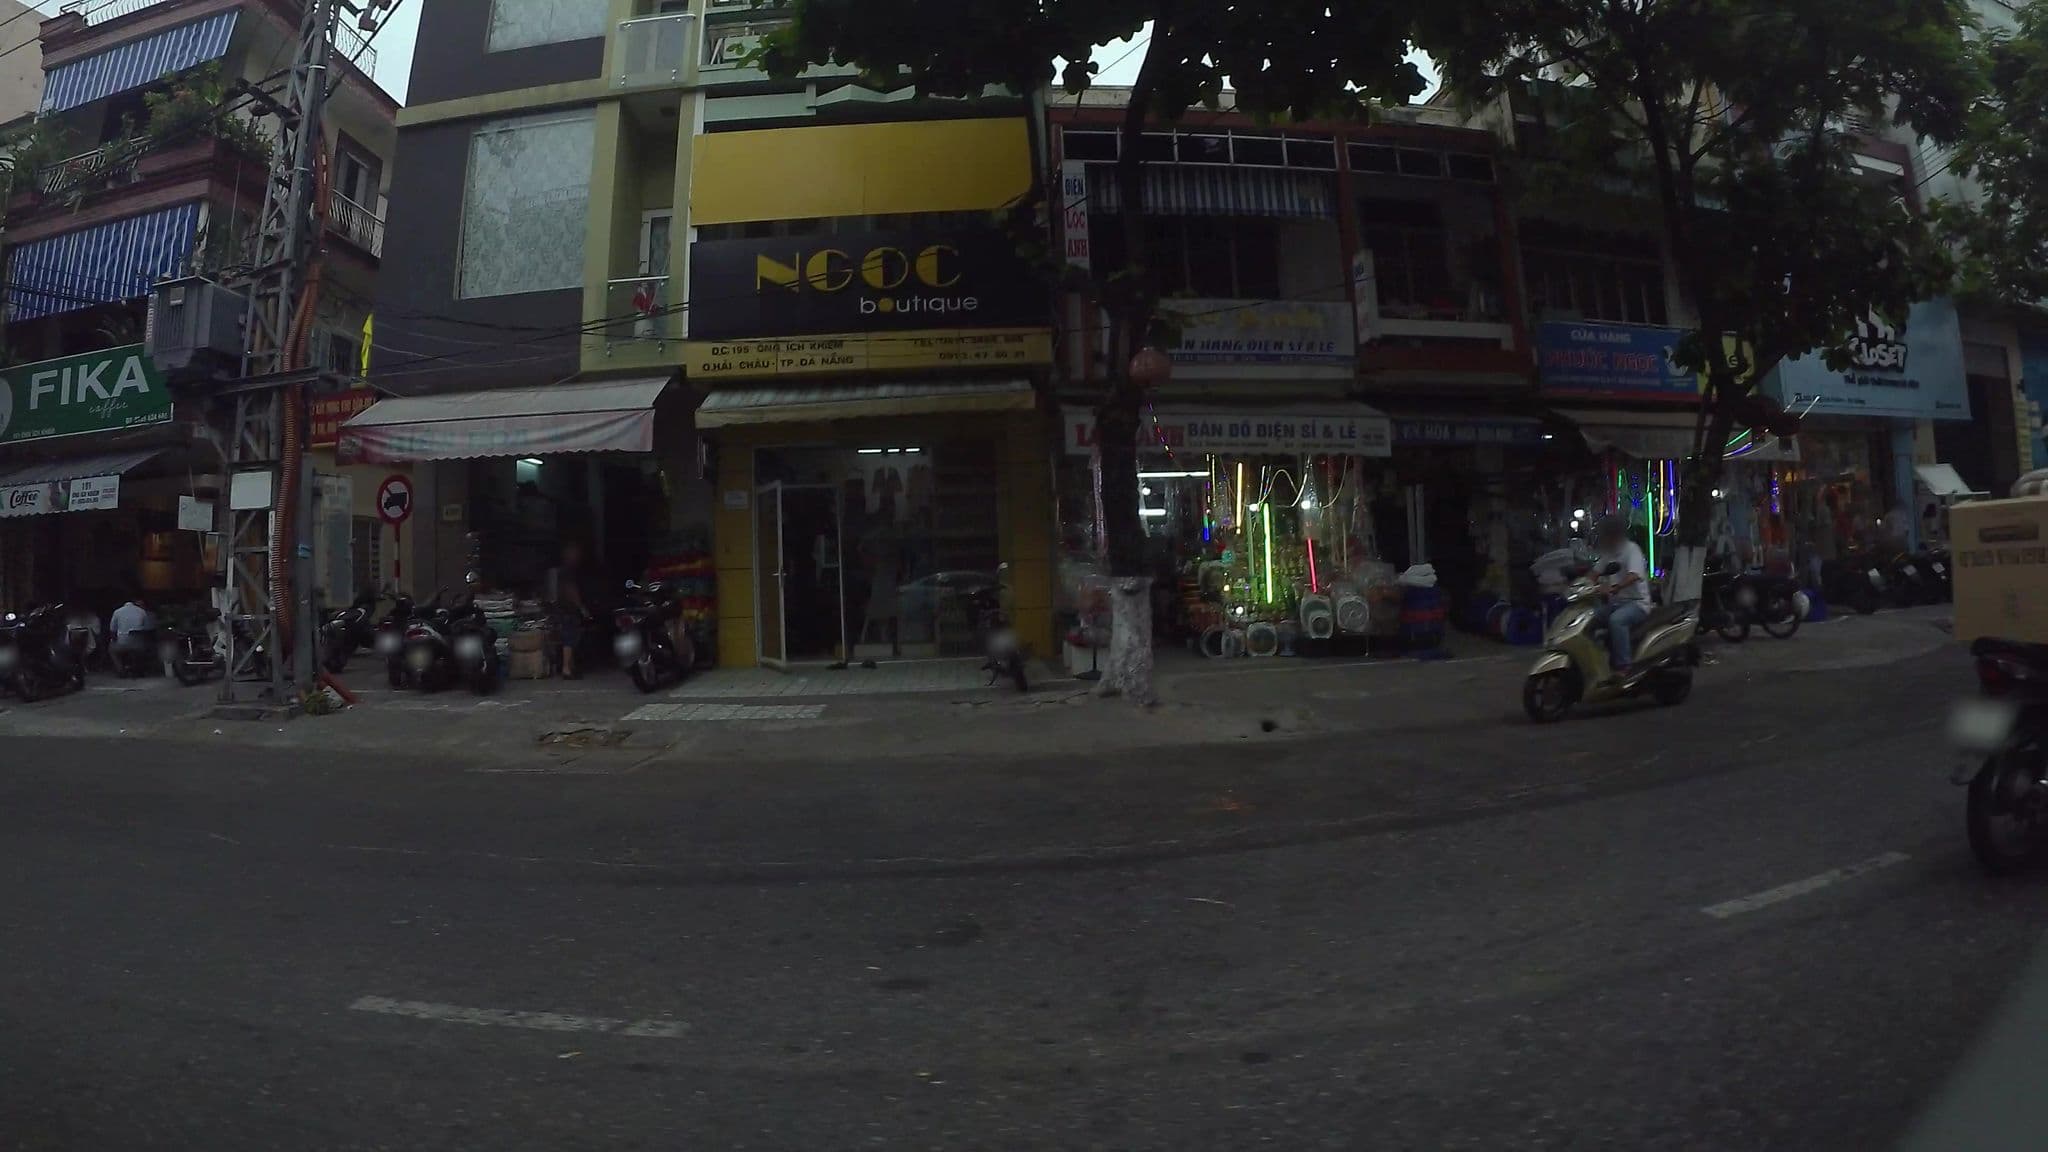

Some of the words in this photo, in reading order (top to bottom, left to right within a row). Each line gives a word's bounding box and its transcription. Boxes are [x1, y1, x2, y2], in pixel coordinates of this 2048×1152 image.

[860, 296, 980, 314] boutique
[29, 354, 150, 410] FIKA
[10, 489, 40, 509] Coffee
